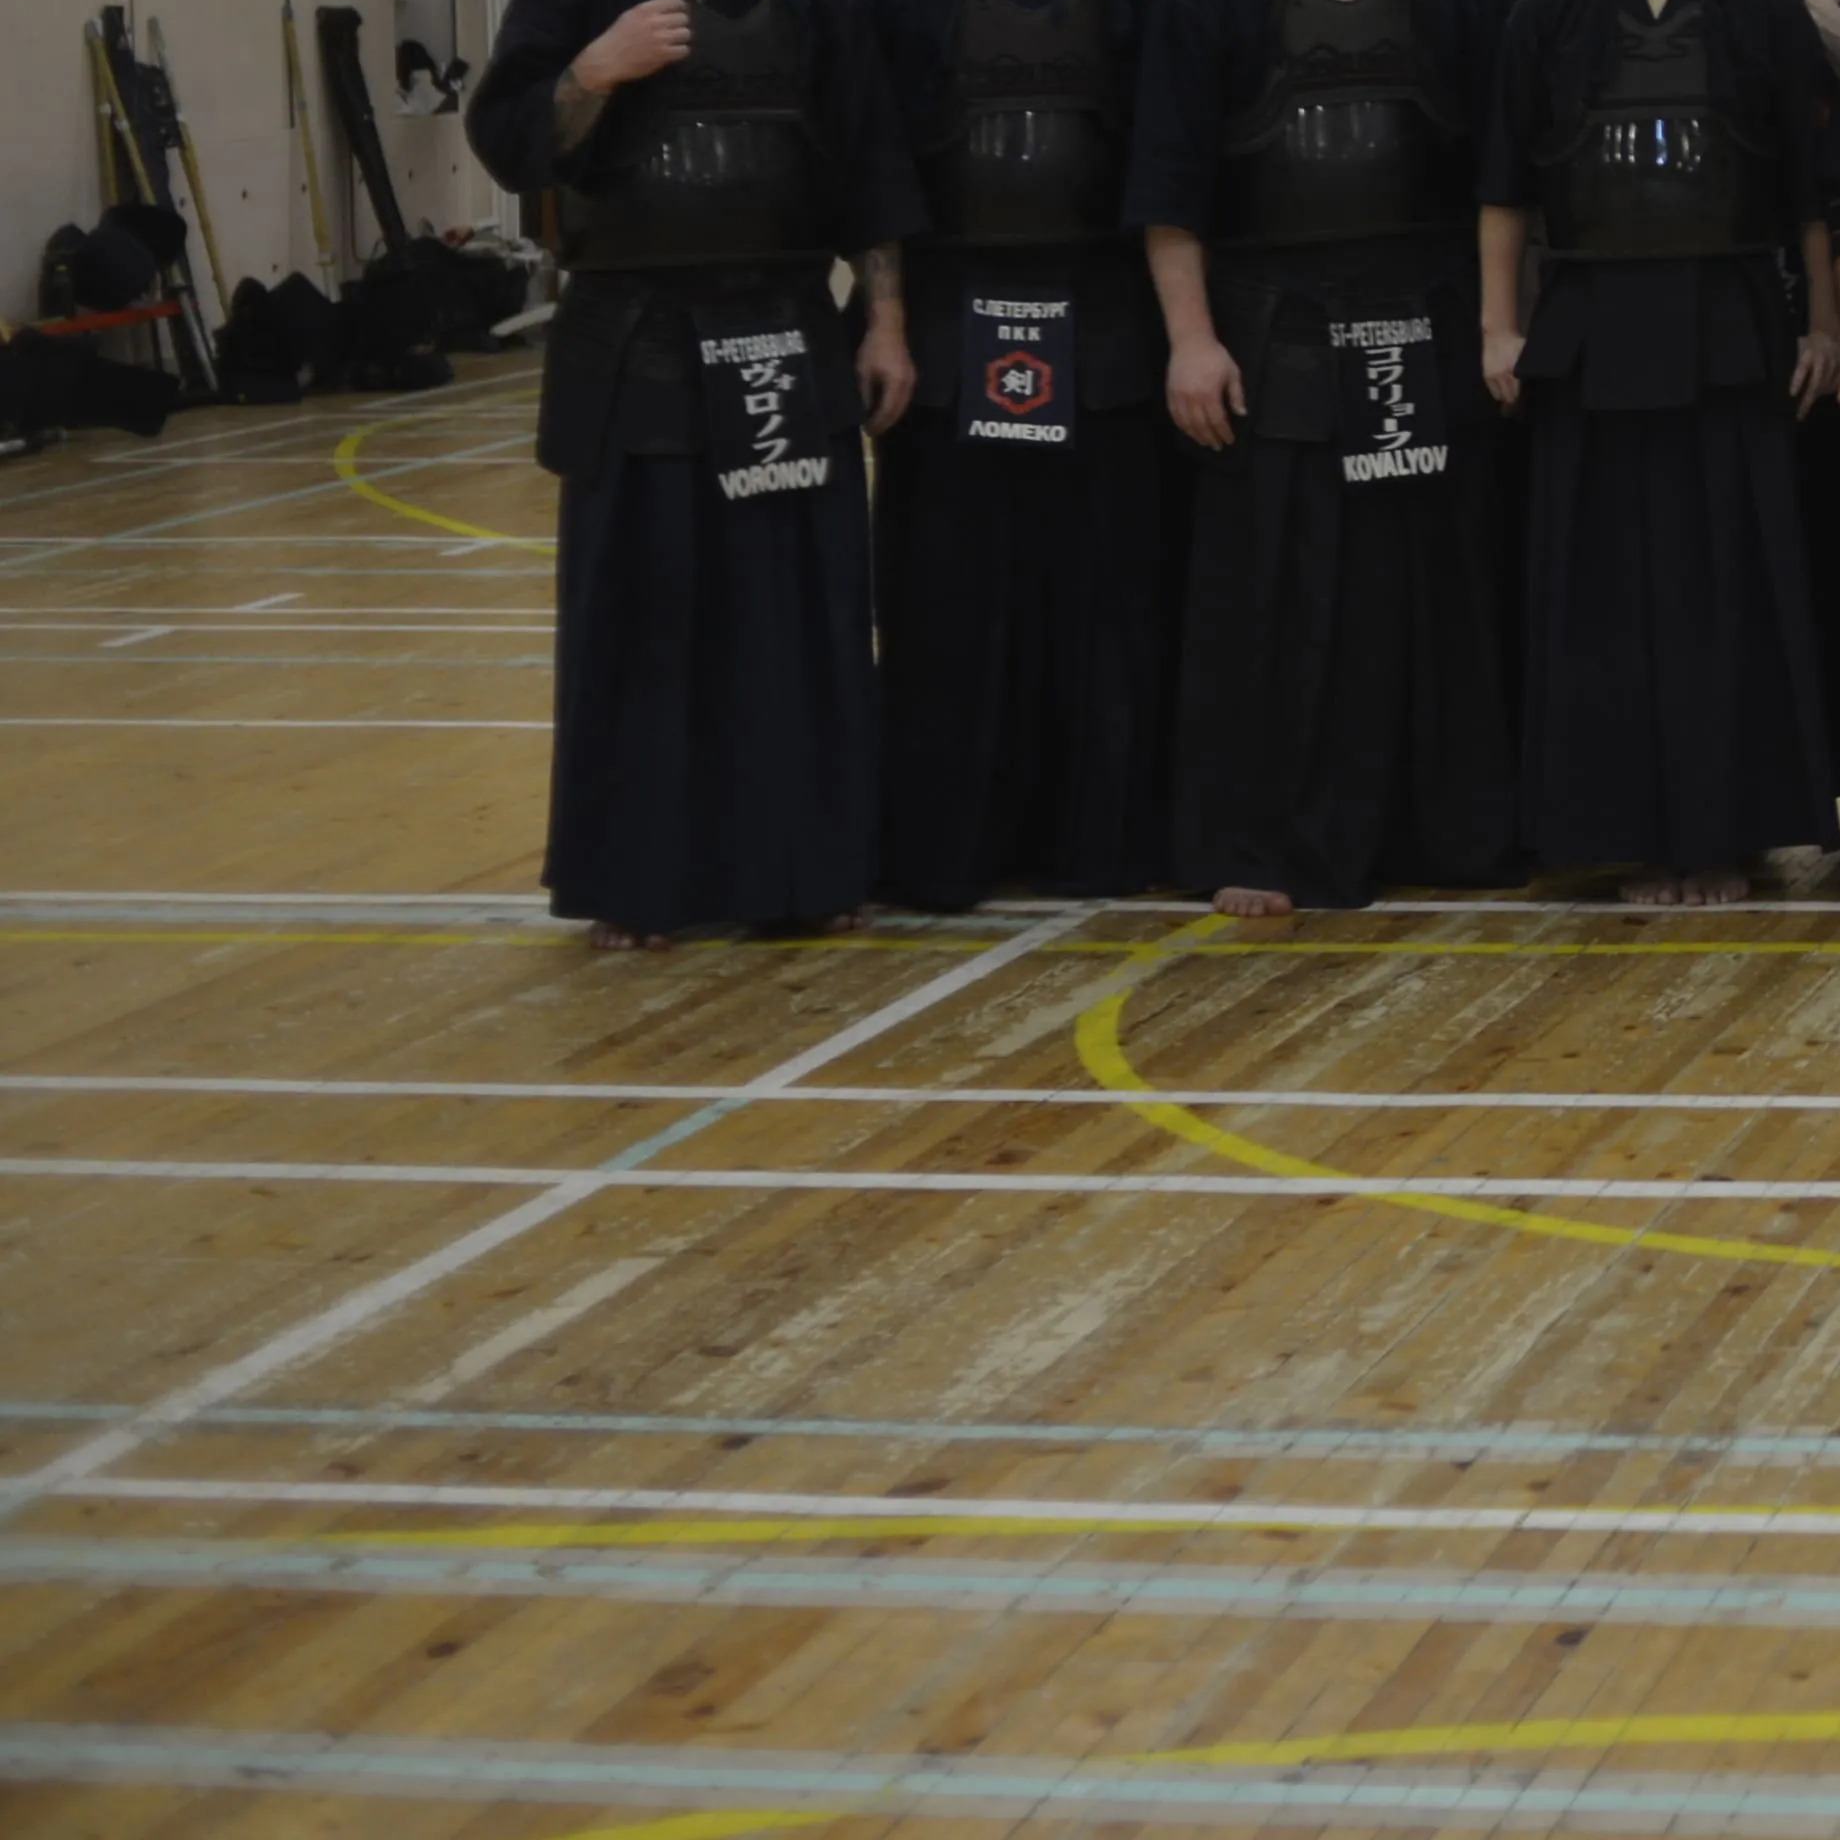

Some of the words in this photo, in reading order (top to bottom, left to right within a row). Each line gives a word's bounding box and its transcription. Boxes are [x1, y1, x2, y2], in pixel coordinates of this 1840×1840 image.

[700, 328, 809, 366] ST-PETERSBURG
[1328, 316, 1434, 348] ST-PETERSBURG
[967, 420, 1069, 443] ЛОМЕКО
[717, 456, 833, 502] VORONOV
[1342, 445, 1450, 483] KOVALYOV
